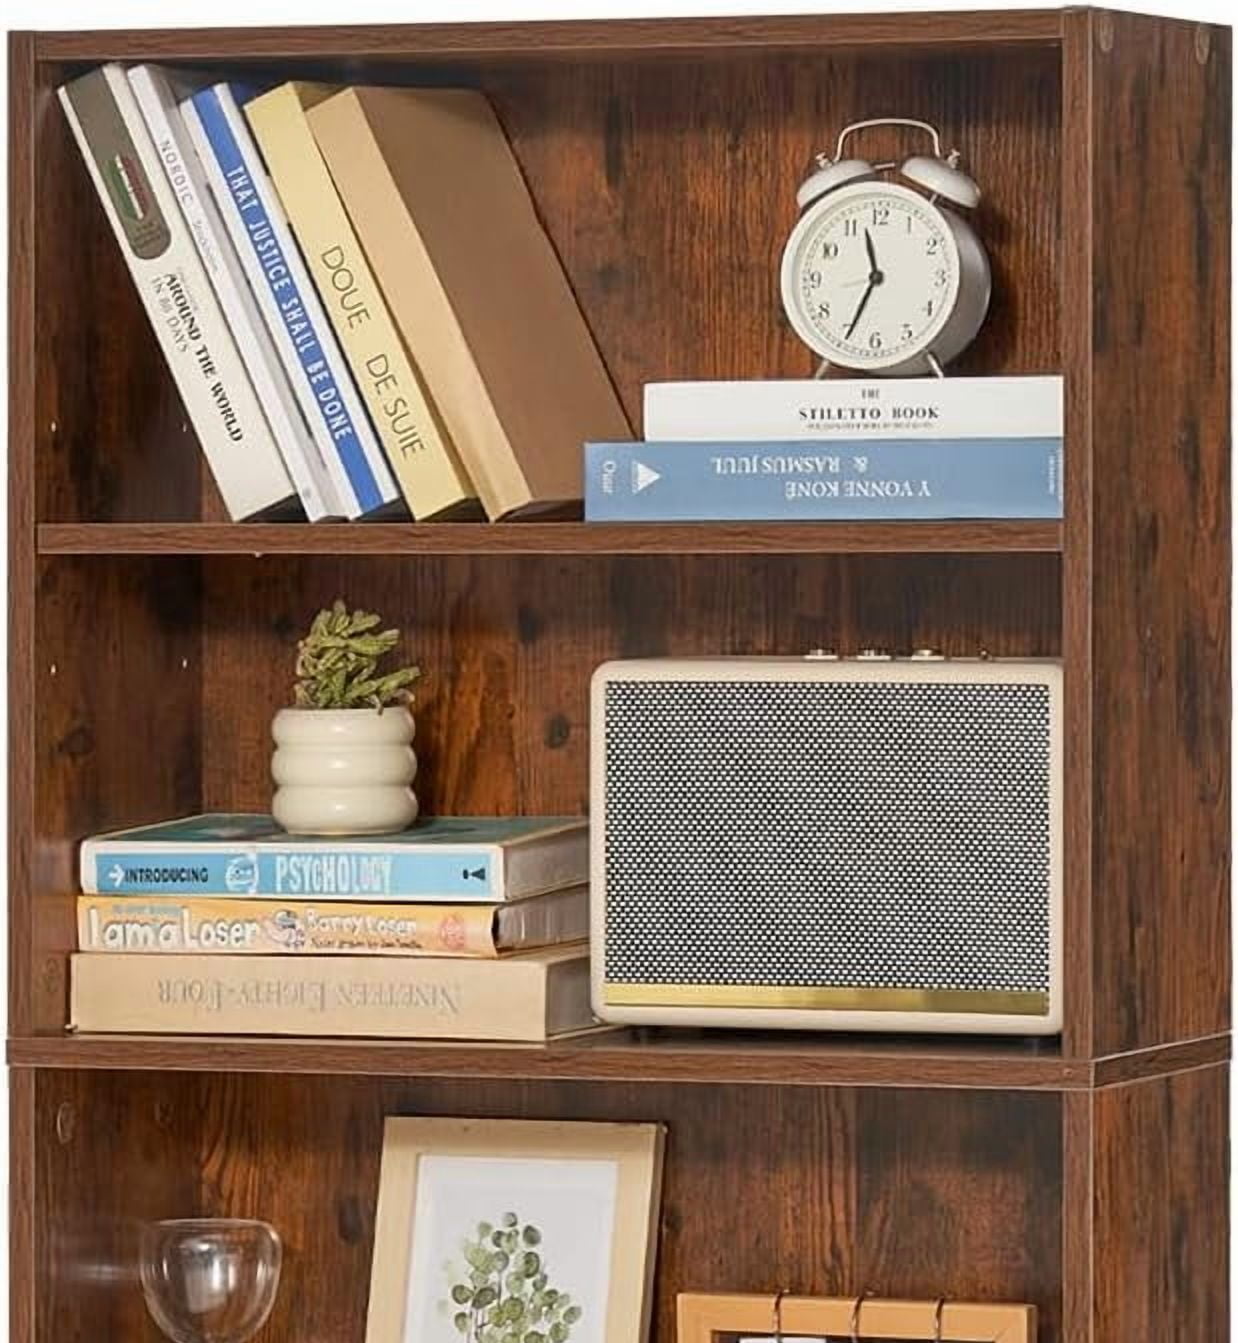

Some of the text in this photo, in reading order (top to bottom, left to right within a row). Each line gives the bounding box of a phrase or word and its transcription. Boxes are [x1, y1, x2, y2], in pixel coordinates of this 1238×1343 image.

[160, 140, 194, 206] NORDIC
[872, 208, 890, 226] 12
[907, 216, 912, 234] 1
[844, 219, 857, 236] 11
[822, 242, 838, 259] 10
[926, 238, 937, 255] 2
[810, 271, 821, 288] 9
[934, 269, 946, 287] 3
[227, 166, 353, 441] THAT JUSTICE SHALL BE DONE
[818, 303, 830, 319] 8
[922, 300, 933, 317] 4
[166, 316, 188, 352] DAYS
[869, 332, 882, 349] 6
[901, 323, 912, 340] 5
[163, 273, 202, 341] AROUND
[195, 344, 217, 379] THE
[211, 382, 243, 442] WORLD
[321, 245, 425, 459] DOUE DE SUIE
[799, 407, 939, 421] STILETTO BOOK
[711, 454, 869, 475] & RASMUS JUUL
[124, 864, 209, 883] INTRODUCING
